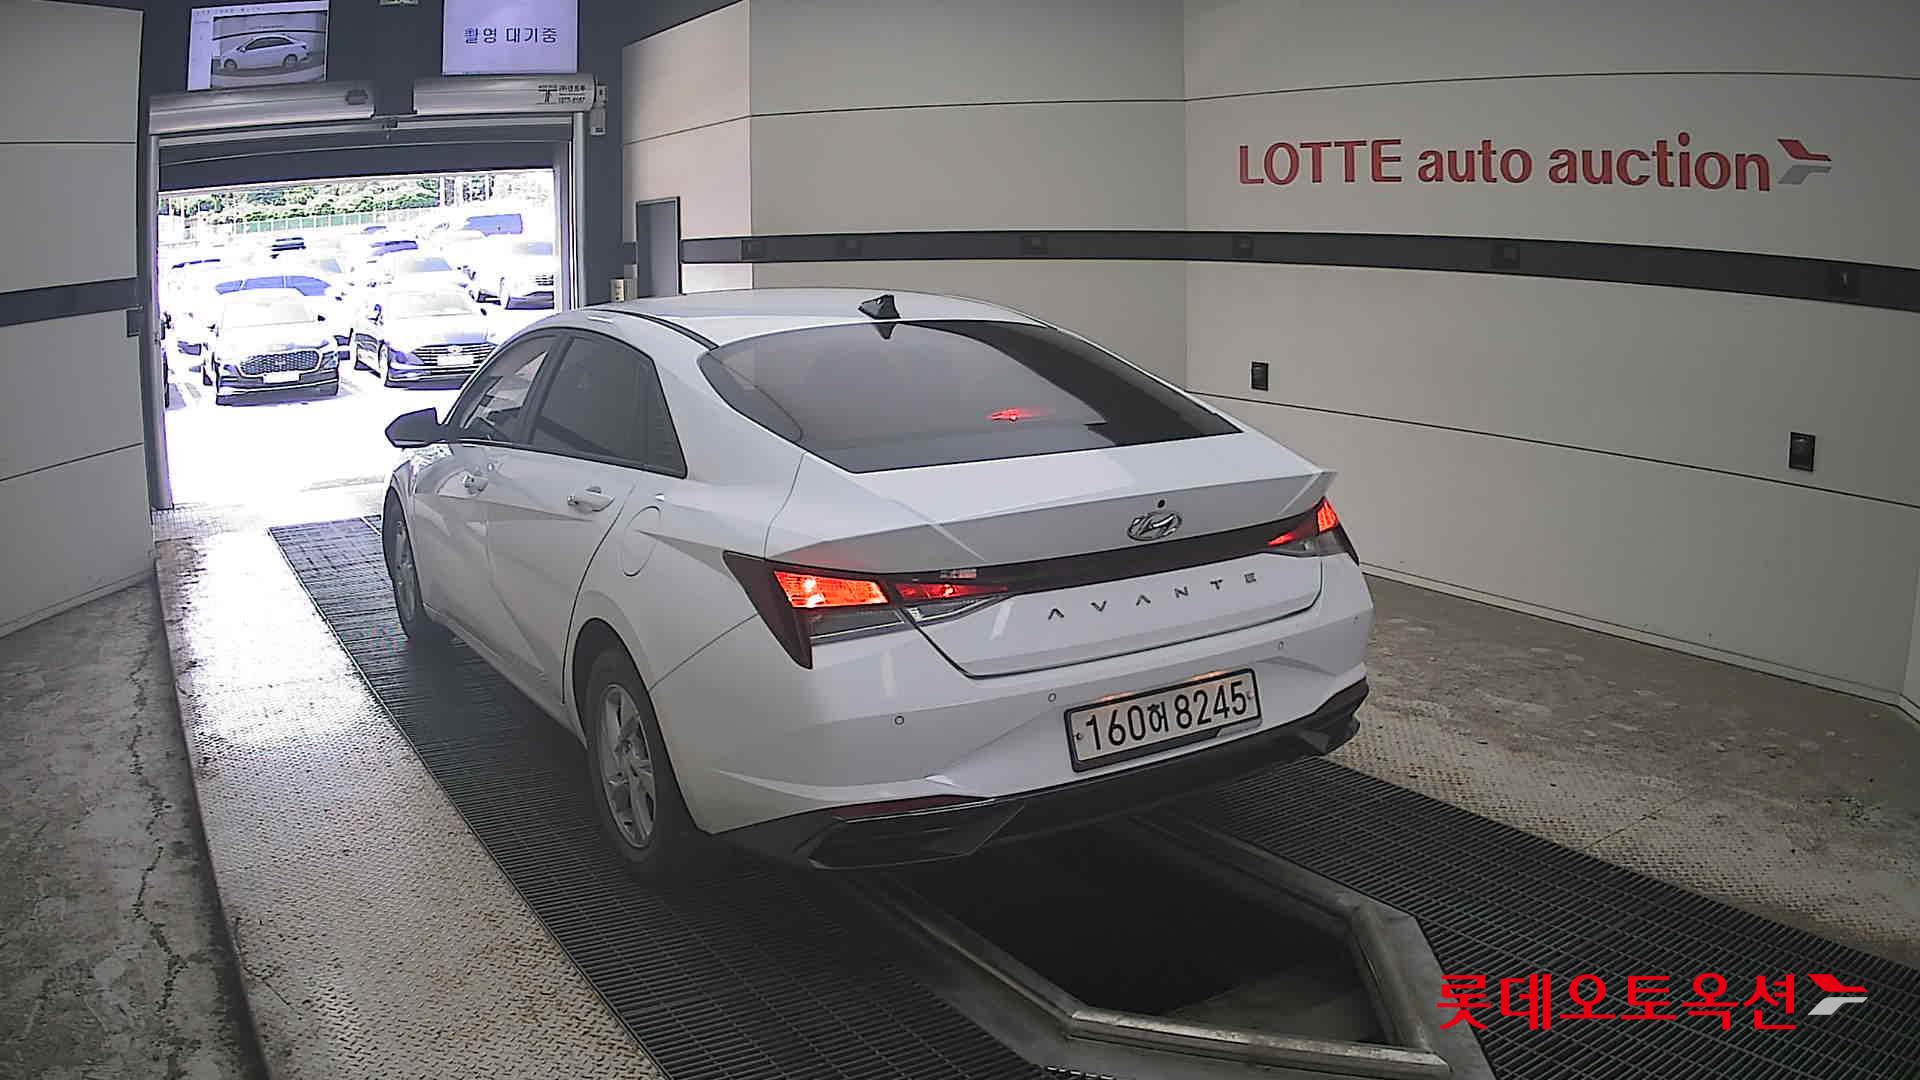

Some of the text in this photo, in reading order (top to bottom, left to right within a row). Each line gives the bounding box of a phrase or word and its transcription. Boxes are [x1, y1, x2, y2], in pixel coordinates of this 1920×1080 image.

[464, 27, 557, 44] 촬영 대기중
[1239, 131, 1772, 191] LOTTE auto auction
[1047, 572, 1257, 620] AVANTE
